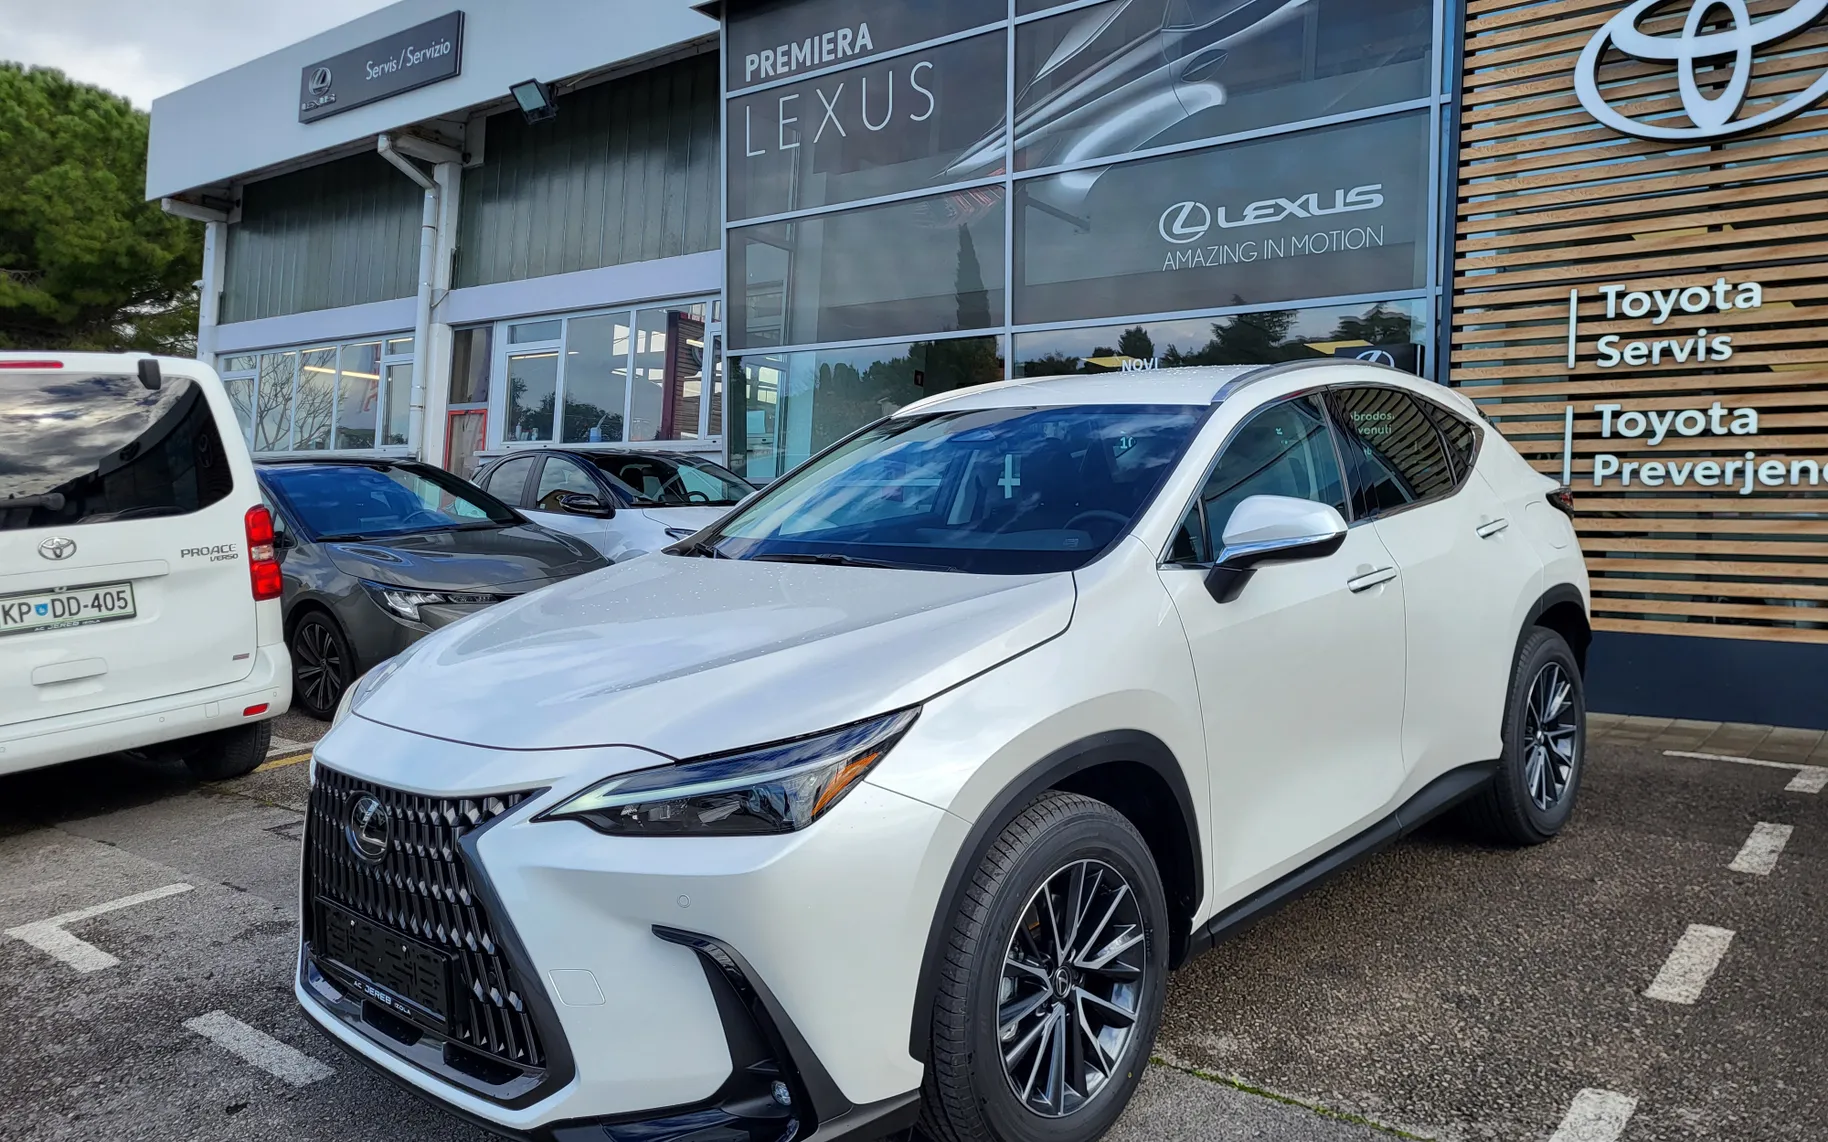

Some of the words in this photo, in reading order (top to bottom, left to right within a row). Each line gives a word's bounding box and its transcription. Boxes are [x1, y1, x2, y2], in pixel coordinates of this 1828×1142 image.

[745, 22, 874, 83] PREMIERA
[746, 61, 934, 157] LEXUS
[1217, 183, 1384, 229] LEXUS
[1162, 241, 1258, 272] AMAZING
[1264, 237, 1284, 260] IN
[1291, 224, 1384, 257] MOTION
[1599, 277, 1762, 325] Toyota
[1596, 328, 1733, 368] Servis
[1594, 401, 1759, 446] Toyota
[1593, 451, 1828, 495] Preverjen
[180, 543, 237, 558] PROACE
[210, 553, 238, 562] VERSO
[1, 602, 32, 625] KP
[50, 590, 128, 619] DD-405
[364, 984, 392, 1005] JEREB
